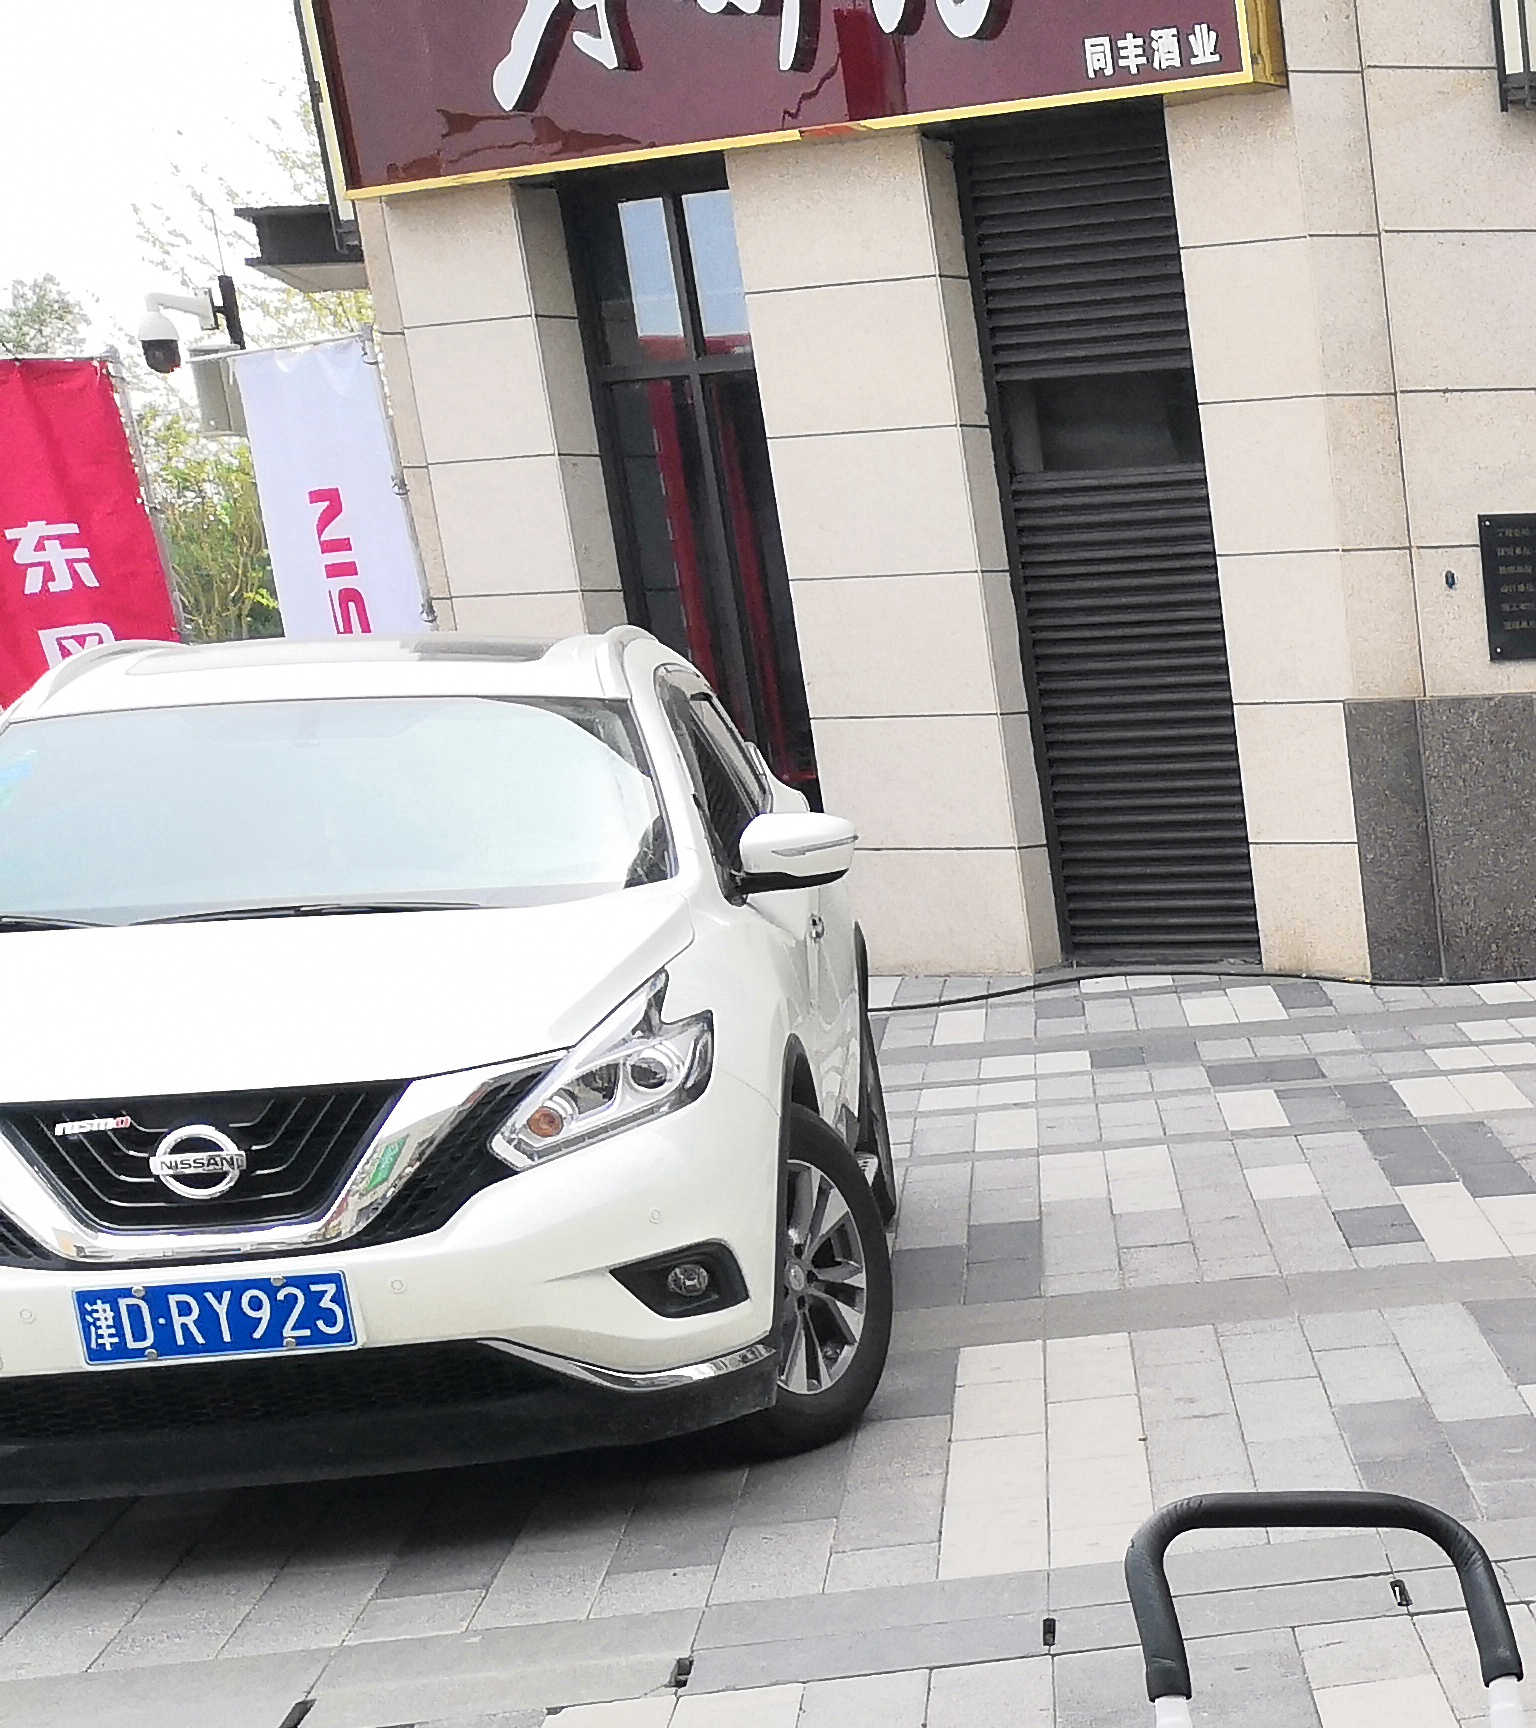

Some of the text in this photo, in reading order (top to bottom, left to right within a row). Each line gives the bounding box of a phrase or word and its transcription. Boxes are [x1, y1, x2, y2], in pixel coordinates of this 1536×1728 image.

[1084, 23, 1221, 79] 同丰酒业
[160, 1154, 236, 1171] NISSAN
